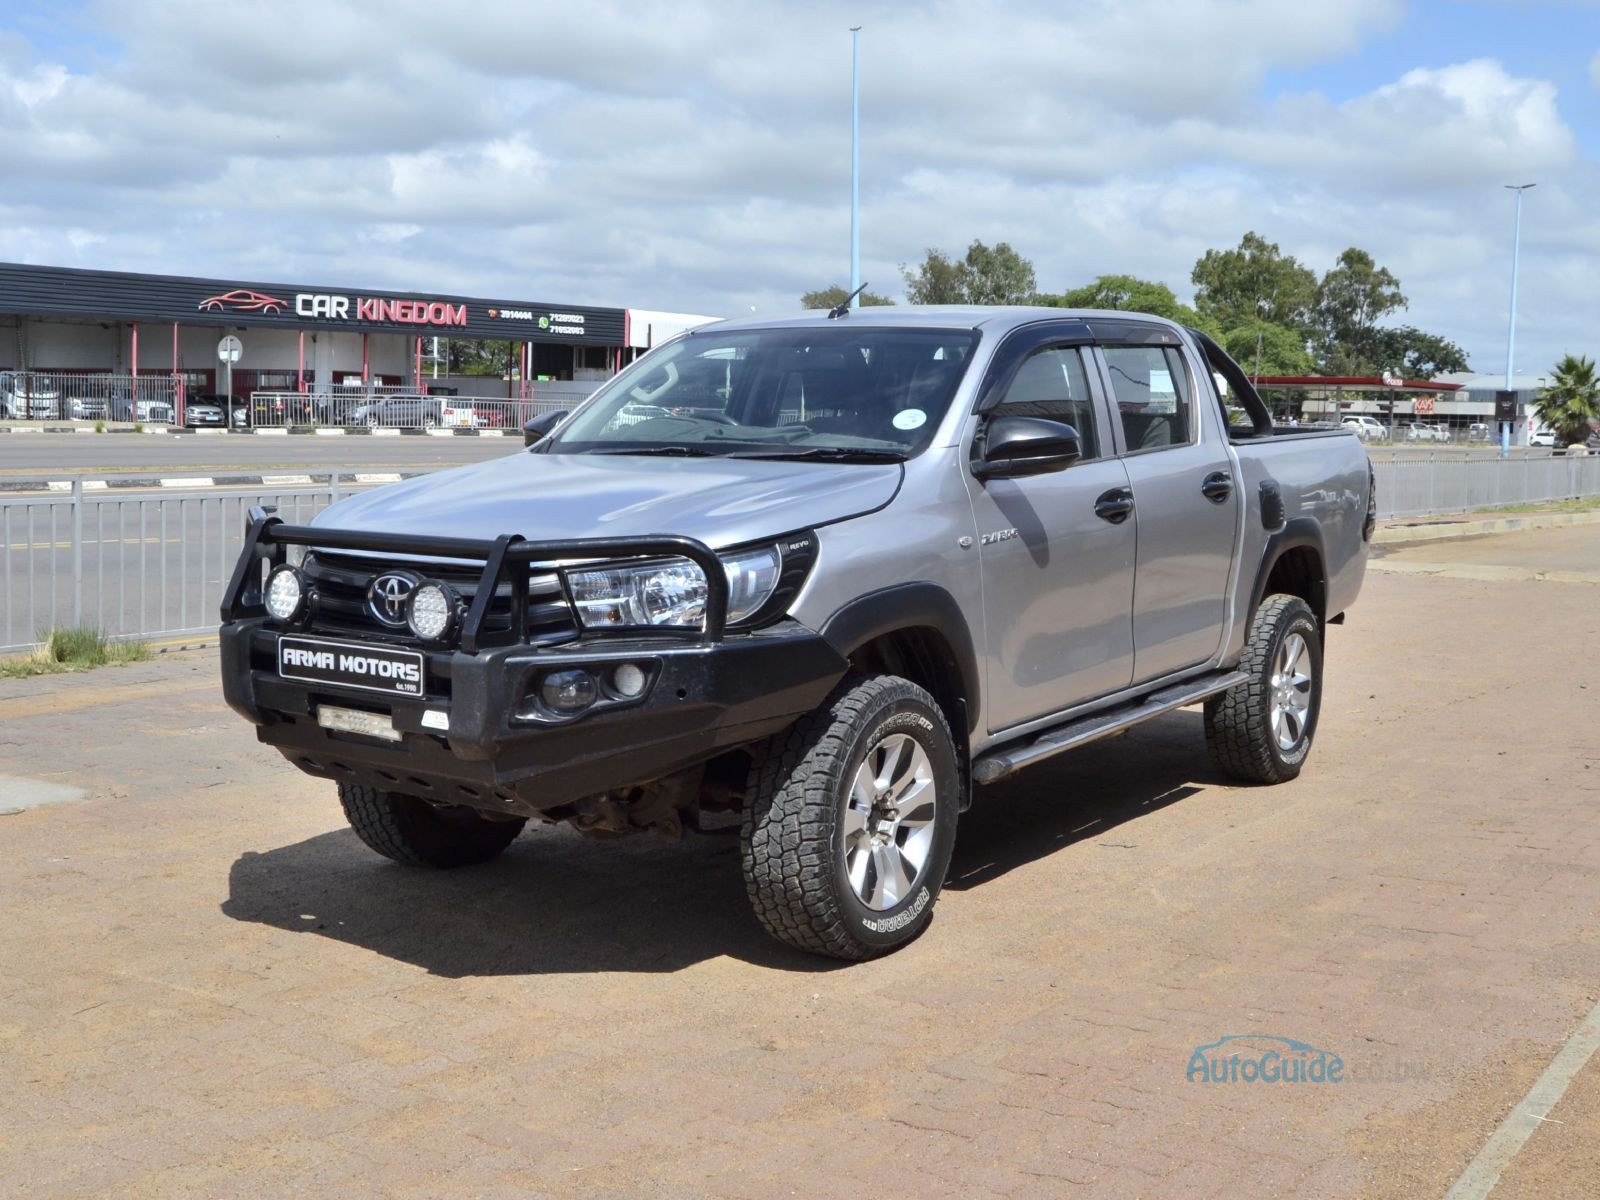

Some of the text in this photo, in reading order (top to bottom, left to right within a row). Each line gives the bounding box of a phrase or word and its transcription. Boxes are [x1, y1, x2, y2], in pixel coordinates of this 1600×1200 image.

[296, 294, 467, 326] CAR KINGDOM
[283, 648, 420, 682] ARMA MOTORS
